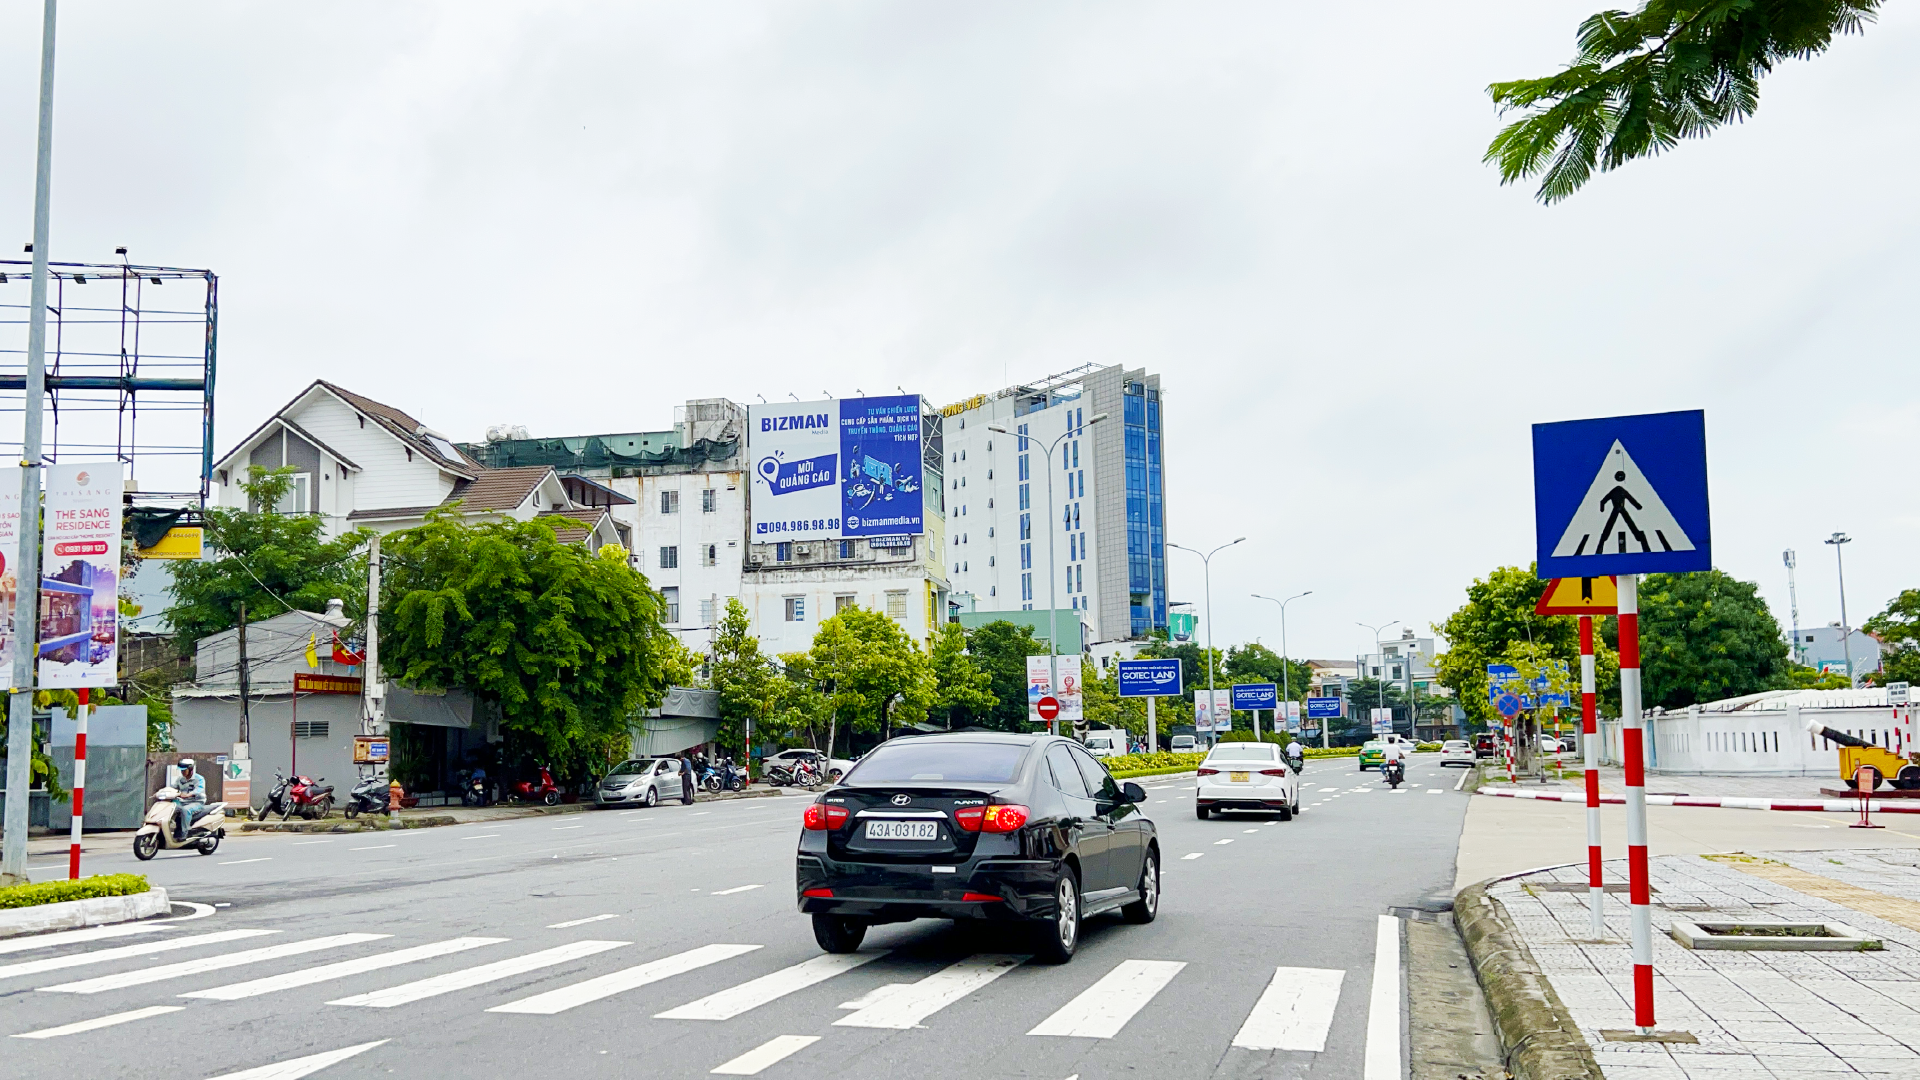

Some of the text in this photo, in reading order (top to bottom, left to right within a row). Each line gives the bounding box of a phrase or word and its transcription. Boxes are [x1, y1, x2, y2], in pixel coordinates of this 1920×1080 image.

[967, 394, 986, 411] VIỆT
[762, 414, 829, 432] BIZMAN
[894, 434, 918, 442] TÍCH HỢP
[798, 461, 814, 474] MỜI
[780, 470, 830, 488] QUẢNG CÁO
[56, 508, 110, 519] THE SANG
[56, 520, 110, 530] RESIDENCE
[769, 518, 840, 532] 094.986.98.98
[862, 516, 920, 526] bizmanmedia.vn
[1122, 671, 1176, 679] GOTEC LAND
[869, 824, 934, 838] 43A-031.82
